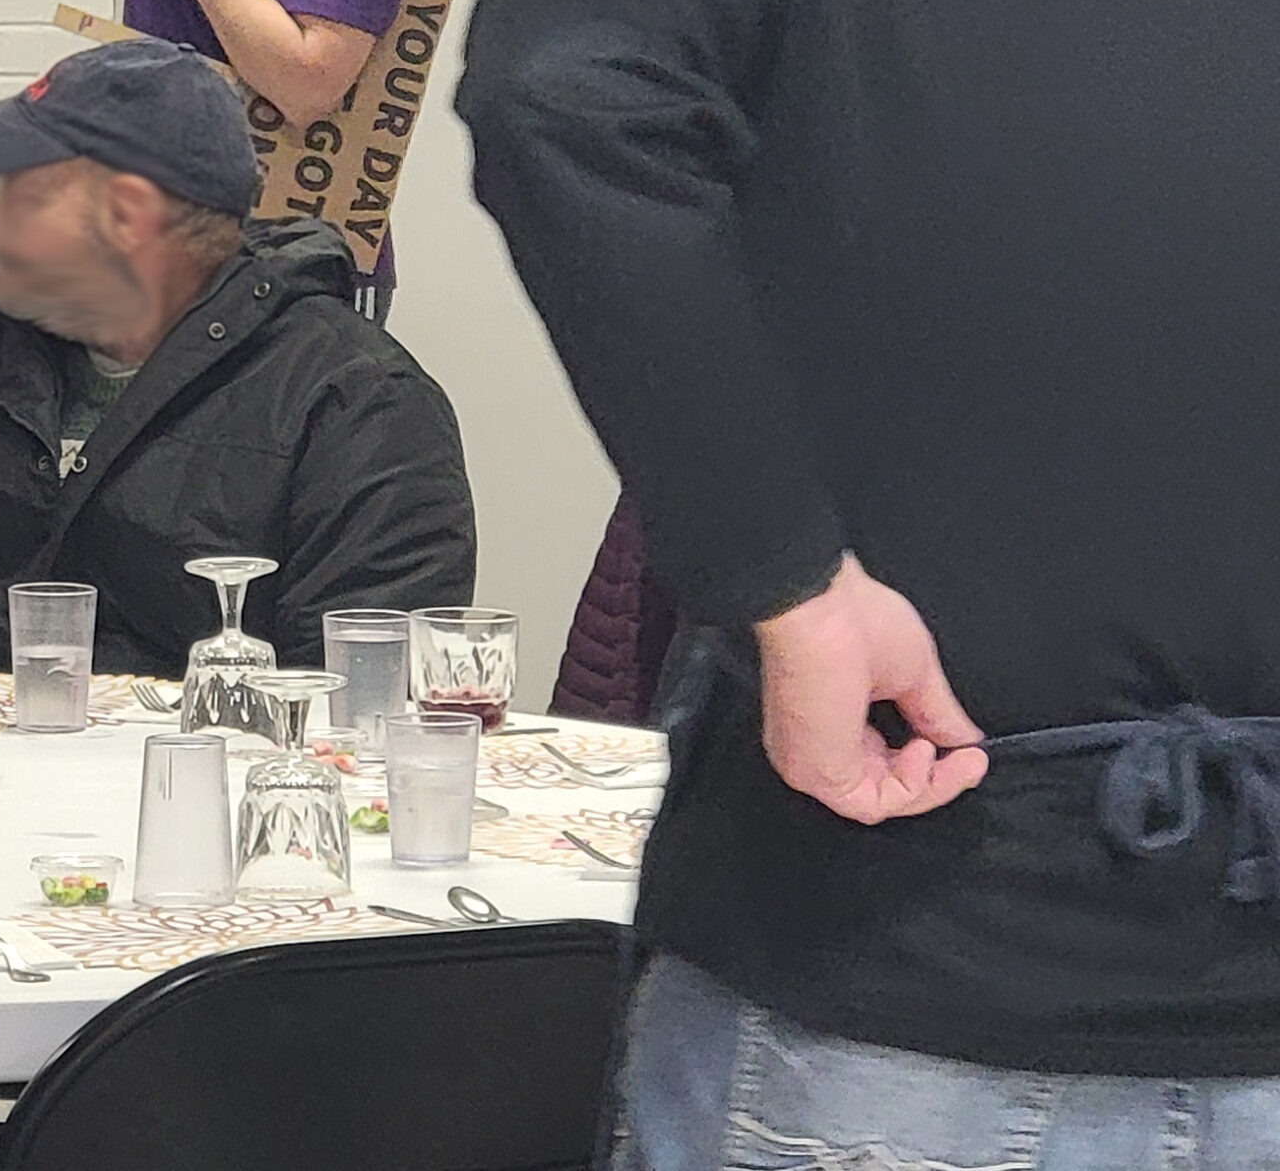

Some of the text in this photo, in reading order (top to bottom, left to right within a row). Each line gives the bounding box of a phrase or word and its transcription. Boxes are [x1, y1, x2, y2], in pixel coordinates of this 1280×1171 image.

[286, 120, 343, 218] GOT
[344, 3, 446, 249] YOUR DAY
